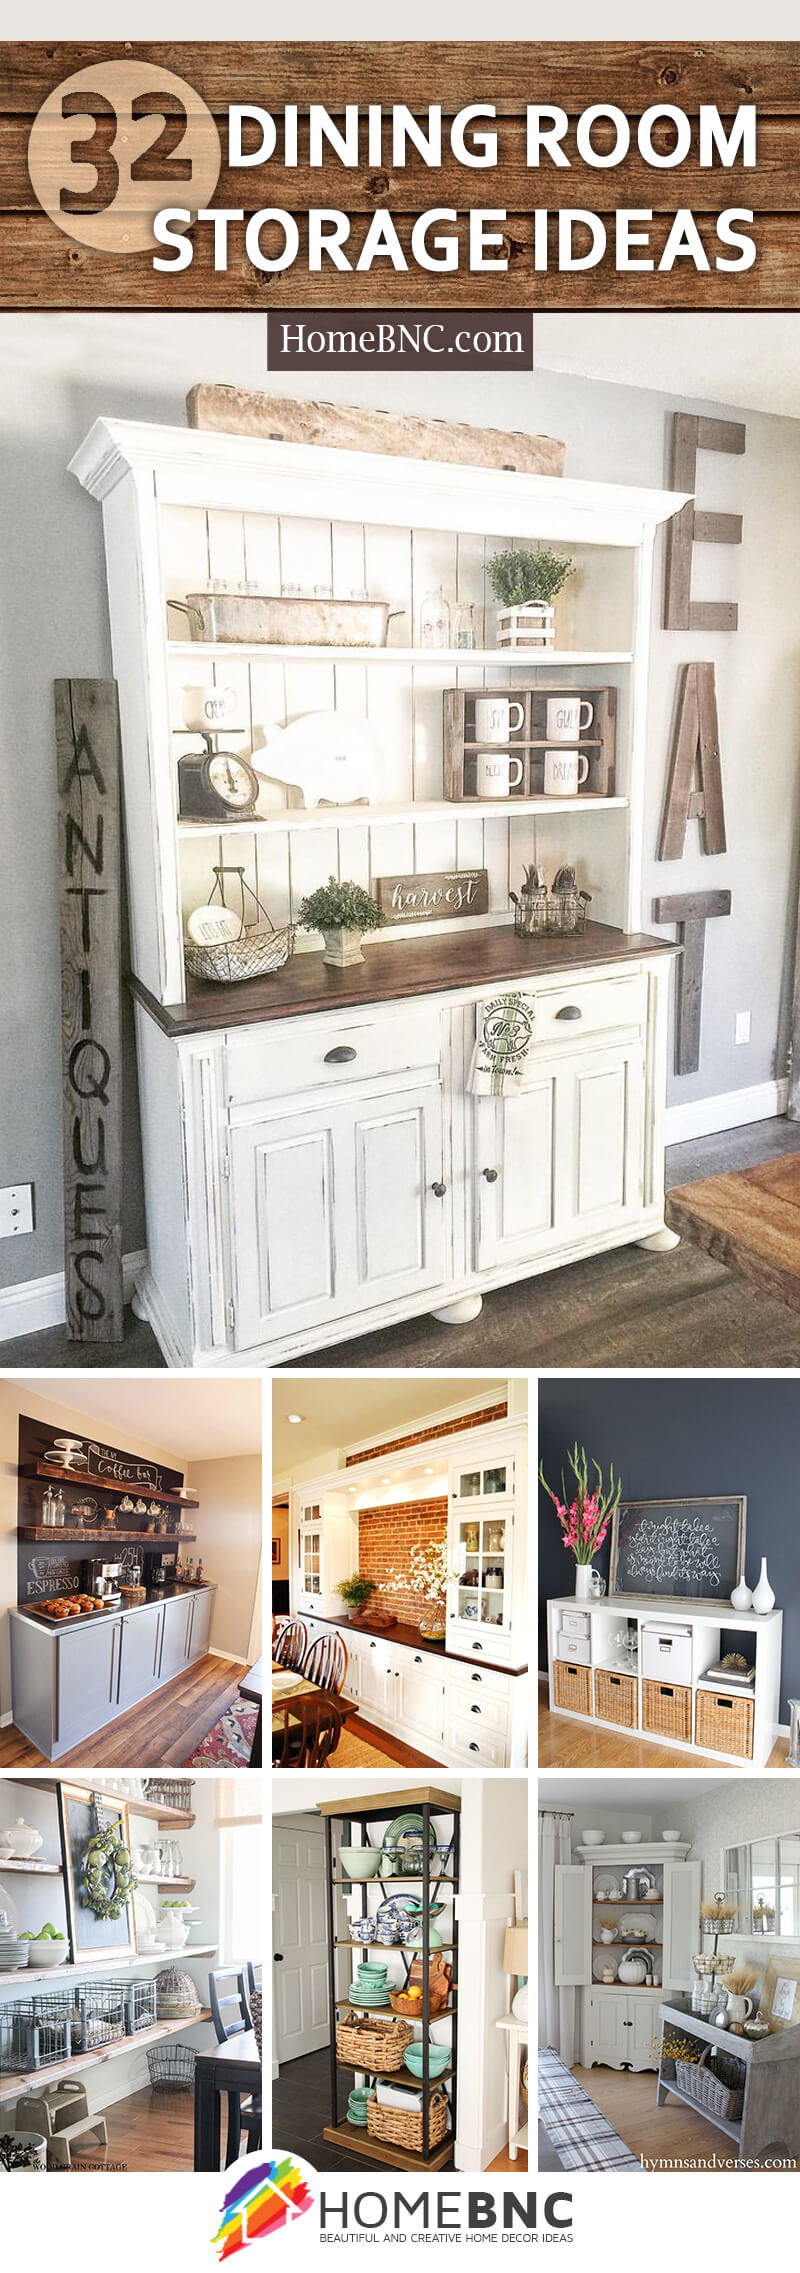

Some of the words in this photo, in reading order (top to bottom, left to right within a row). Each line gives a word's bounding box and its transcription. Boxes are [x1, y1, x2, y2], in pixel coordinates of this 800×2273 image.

[391, 880, 480, 910] harvest
[485, 997, 507, 1013] DAILY
[508, 999, 536, 1021] SPECIAL
[57, 723, 110, 1322] ANTIQUES
[98, 1460, 134, 1480] Coffee
[136, 1466, 151, 1481] bar
[26, 1575, 79, 1595] ESPRESSO
